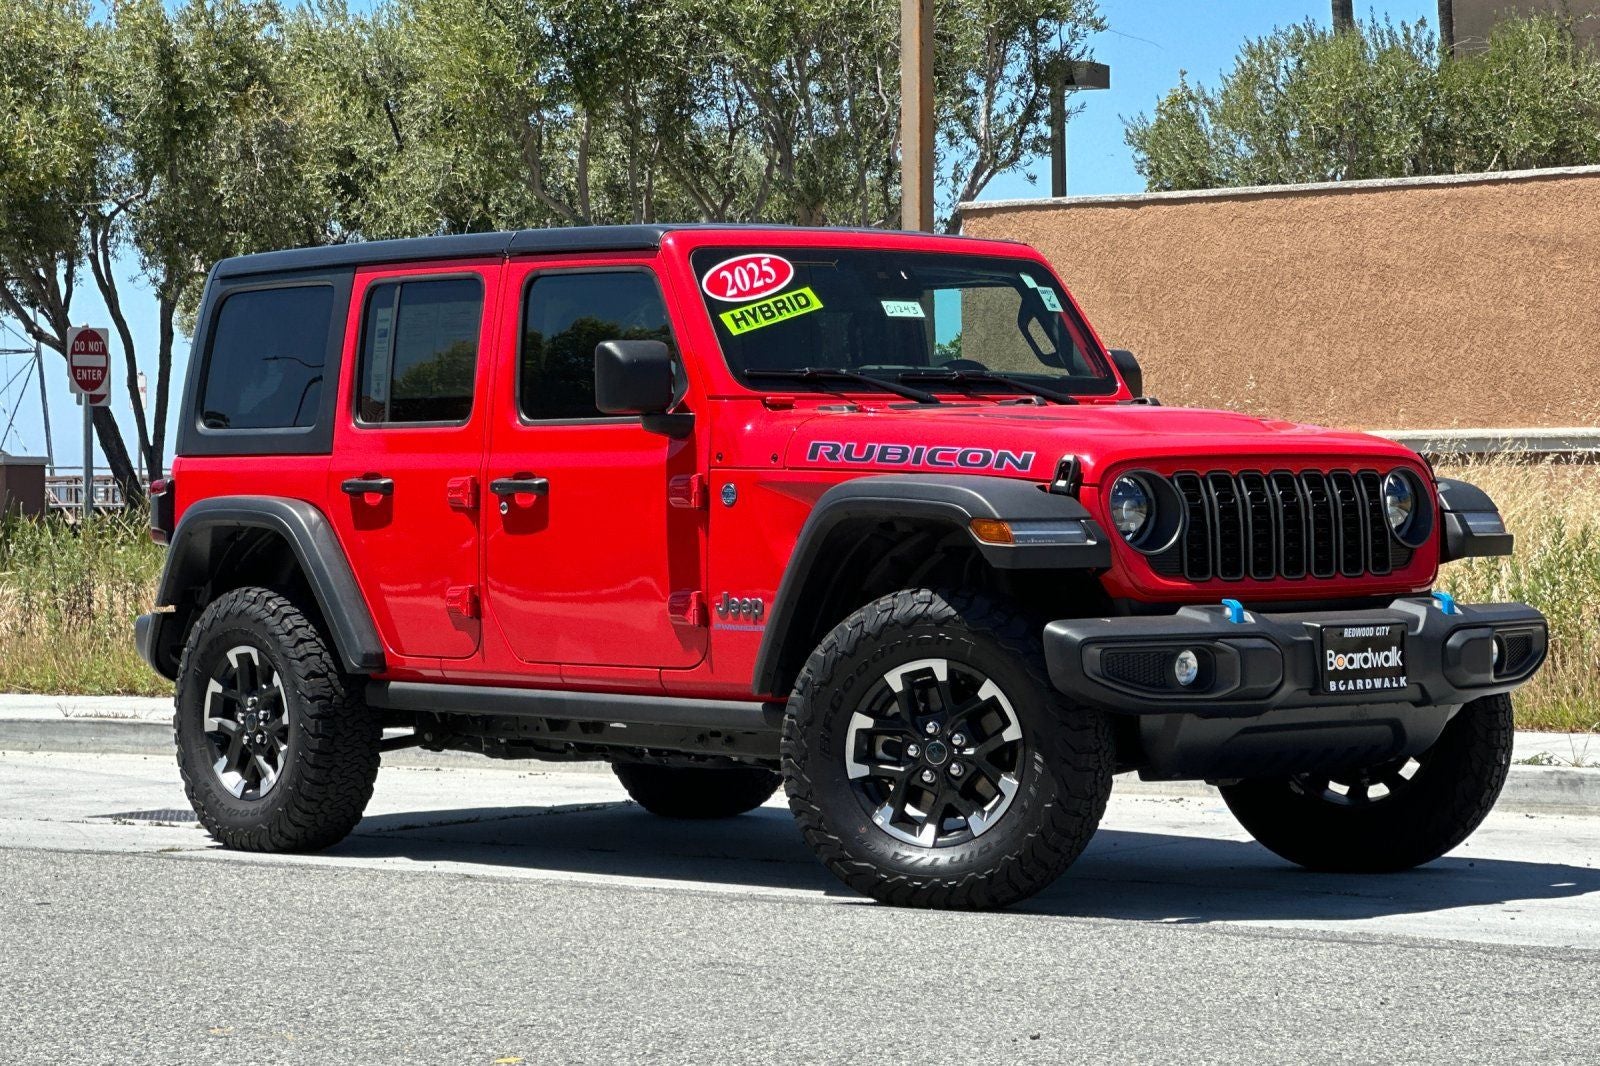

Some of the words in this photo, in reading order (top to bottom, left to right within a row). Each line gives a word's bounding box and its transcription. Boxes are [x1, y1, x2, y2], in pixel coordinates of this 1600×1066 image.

[719, 257, 776, 297] 2025
[730, 292, 812, 330] HYBRID
[74, 341, 85, 352] DO
[88, 341, 104, 353] NOT
[76, 369, 102, 380] ENTER
[806, 440, 1036, 472] RUBICON
[715, 591, 765, 622] Jeep
[1343, 627, 1374, 638] REDWOOD
[1375, 626, 1390, 636] CITY
[1326, 645, 1403, 671] Boardwalk
